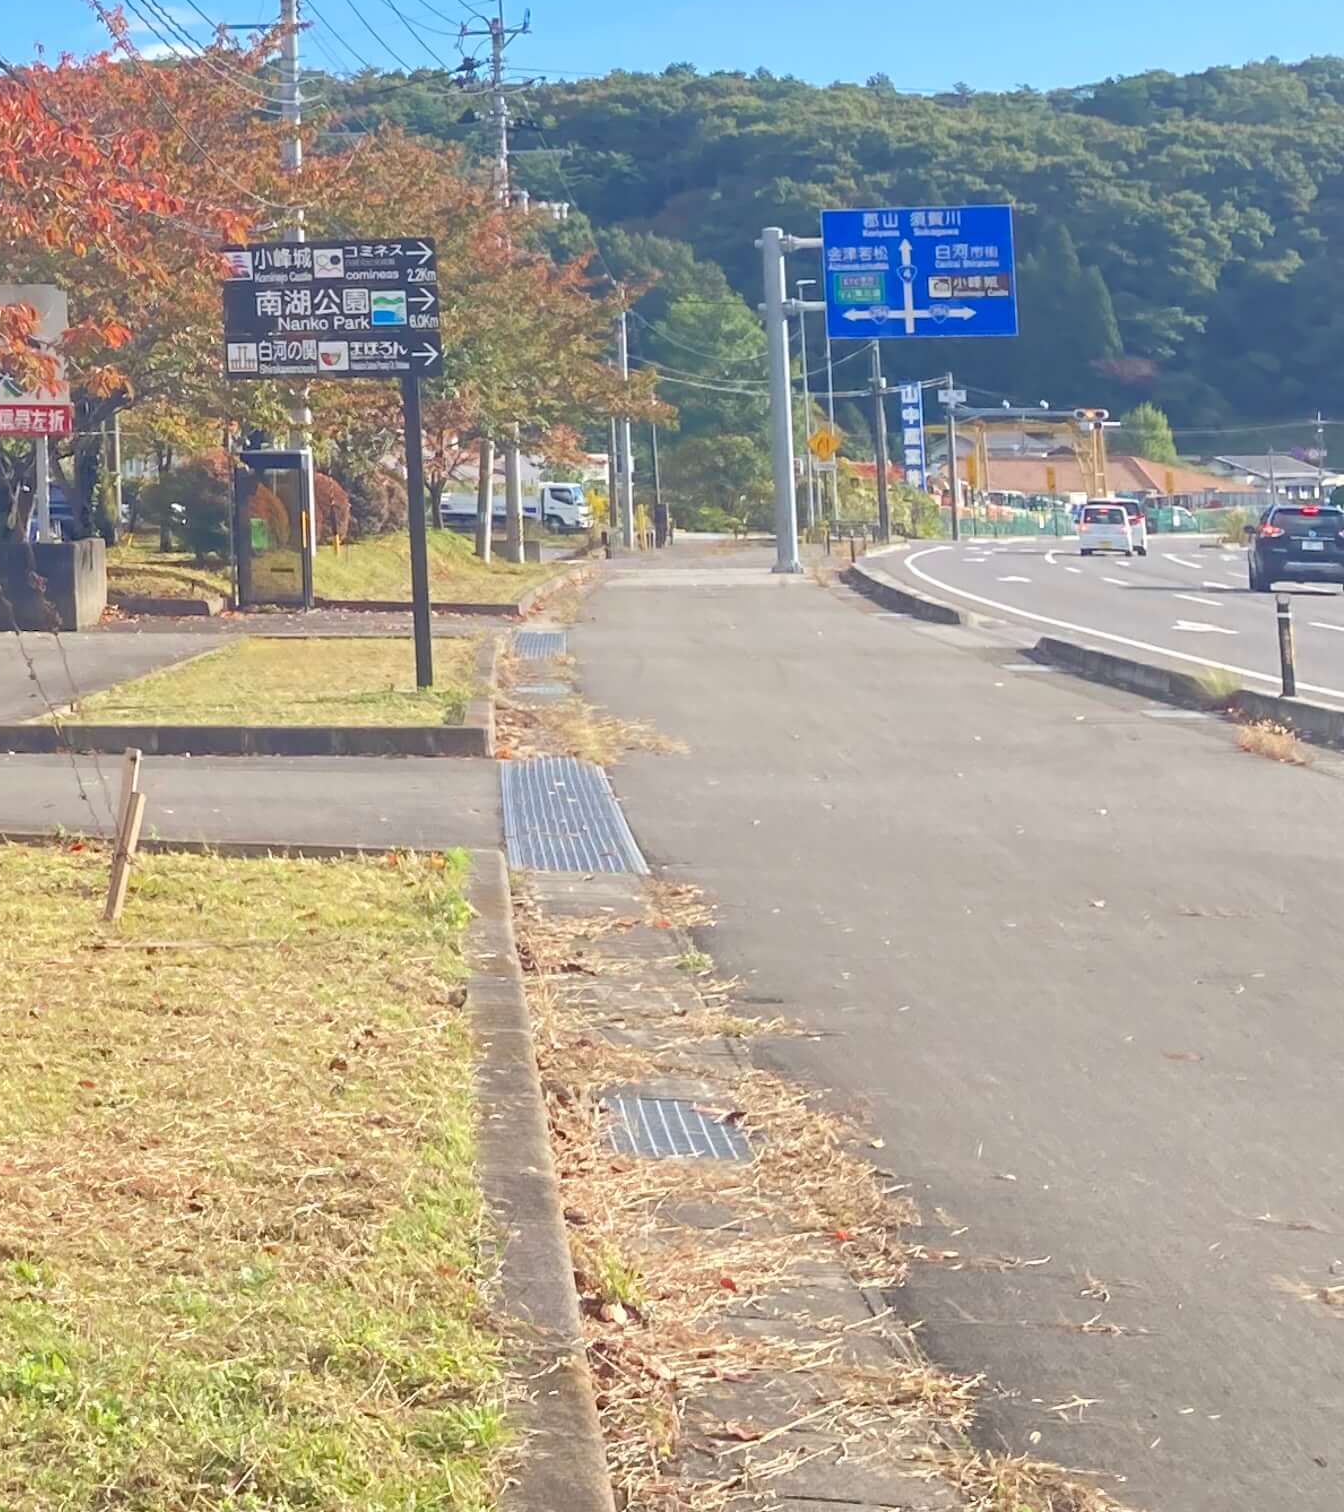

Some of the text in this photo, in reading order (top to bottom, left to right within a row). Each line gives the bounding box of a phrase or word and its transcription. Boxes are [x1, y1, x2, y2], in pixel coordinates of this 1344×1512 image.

[254, 247, 313, 270] 小峰城
[343, 243, 405, 259] コミネス
[255, 288, 370, 317] 南湖公園
[277, 315, 371, 331] Nanko Park
[258, 339, 318, 362] 白河の関
